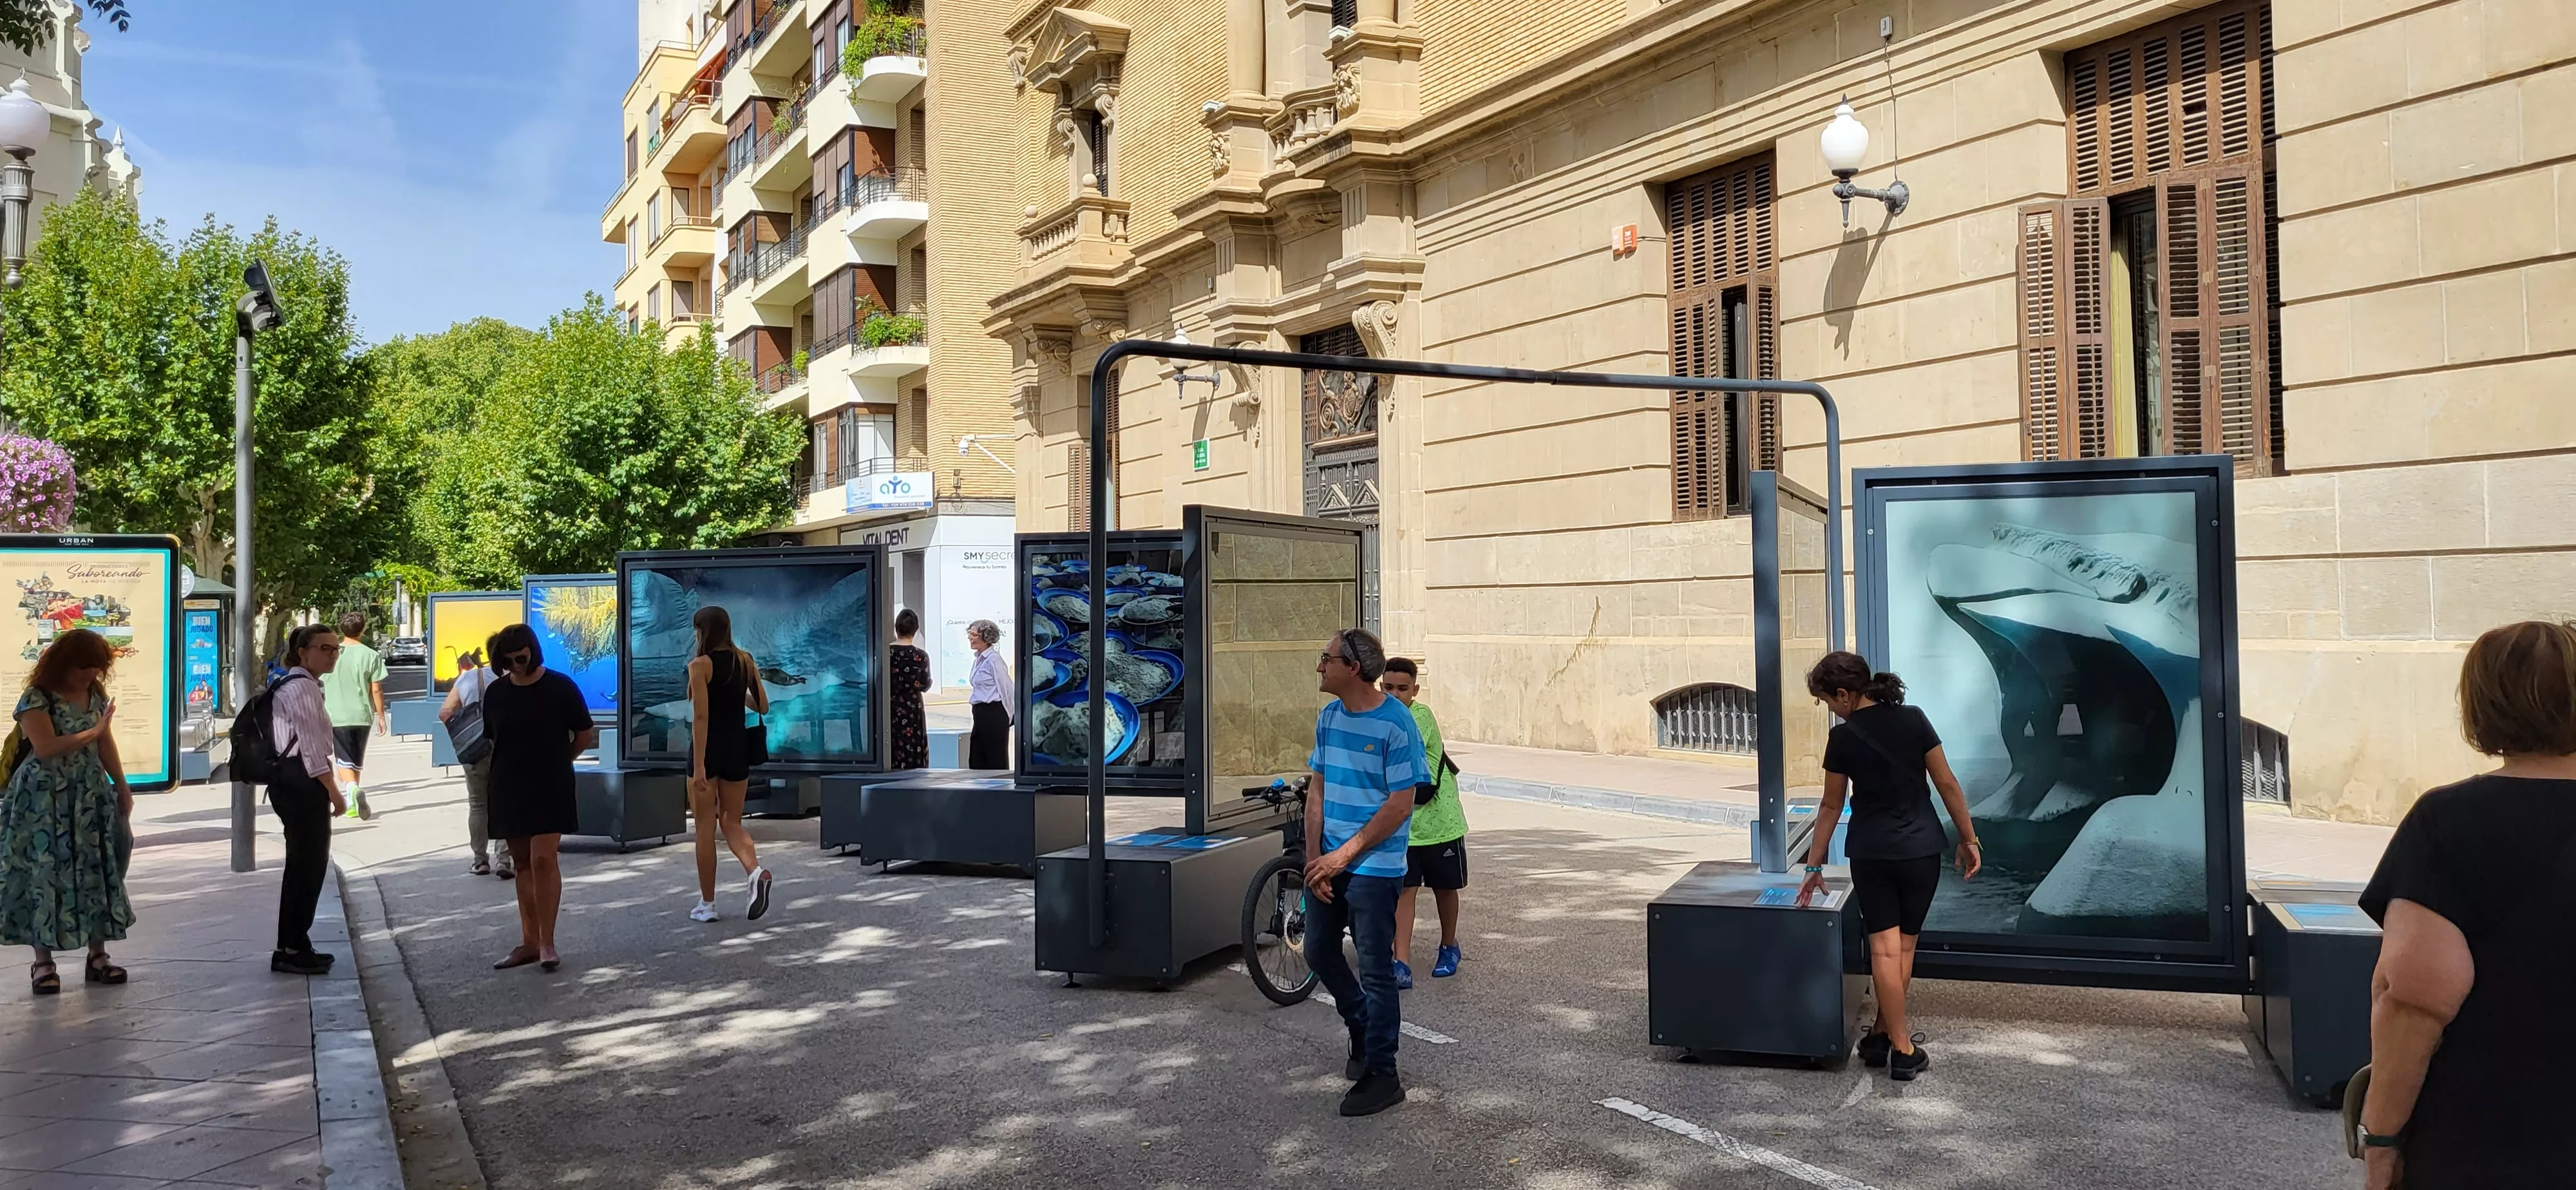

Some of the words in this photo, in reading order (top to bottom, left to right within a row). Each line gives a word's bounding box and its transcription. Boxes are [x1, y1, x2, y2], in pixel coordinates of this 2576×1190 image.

[66, 563, 151, 580] Saboreando
[193, 616, 211, 626] BIEN
[193, 664, 211, 674] BIEN
